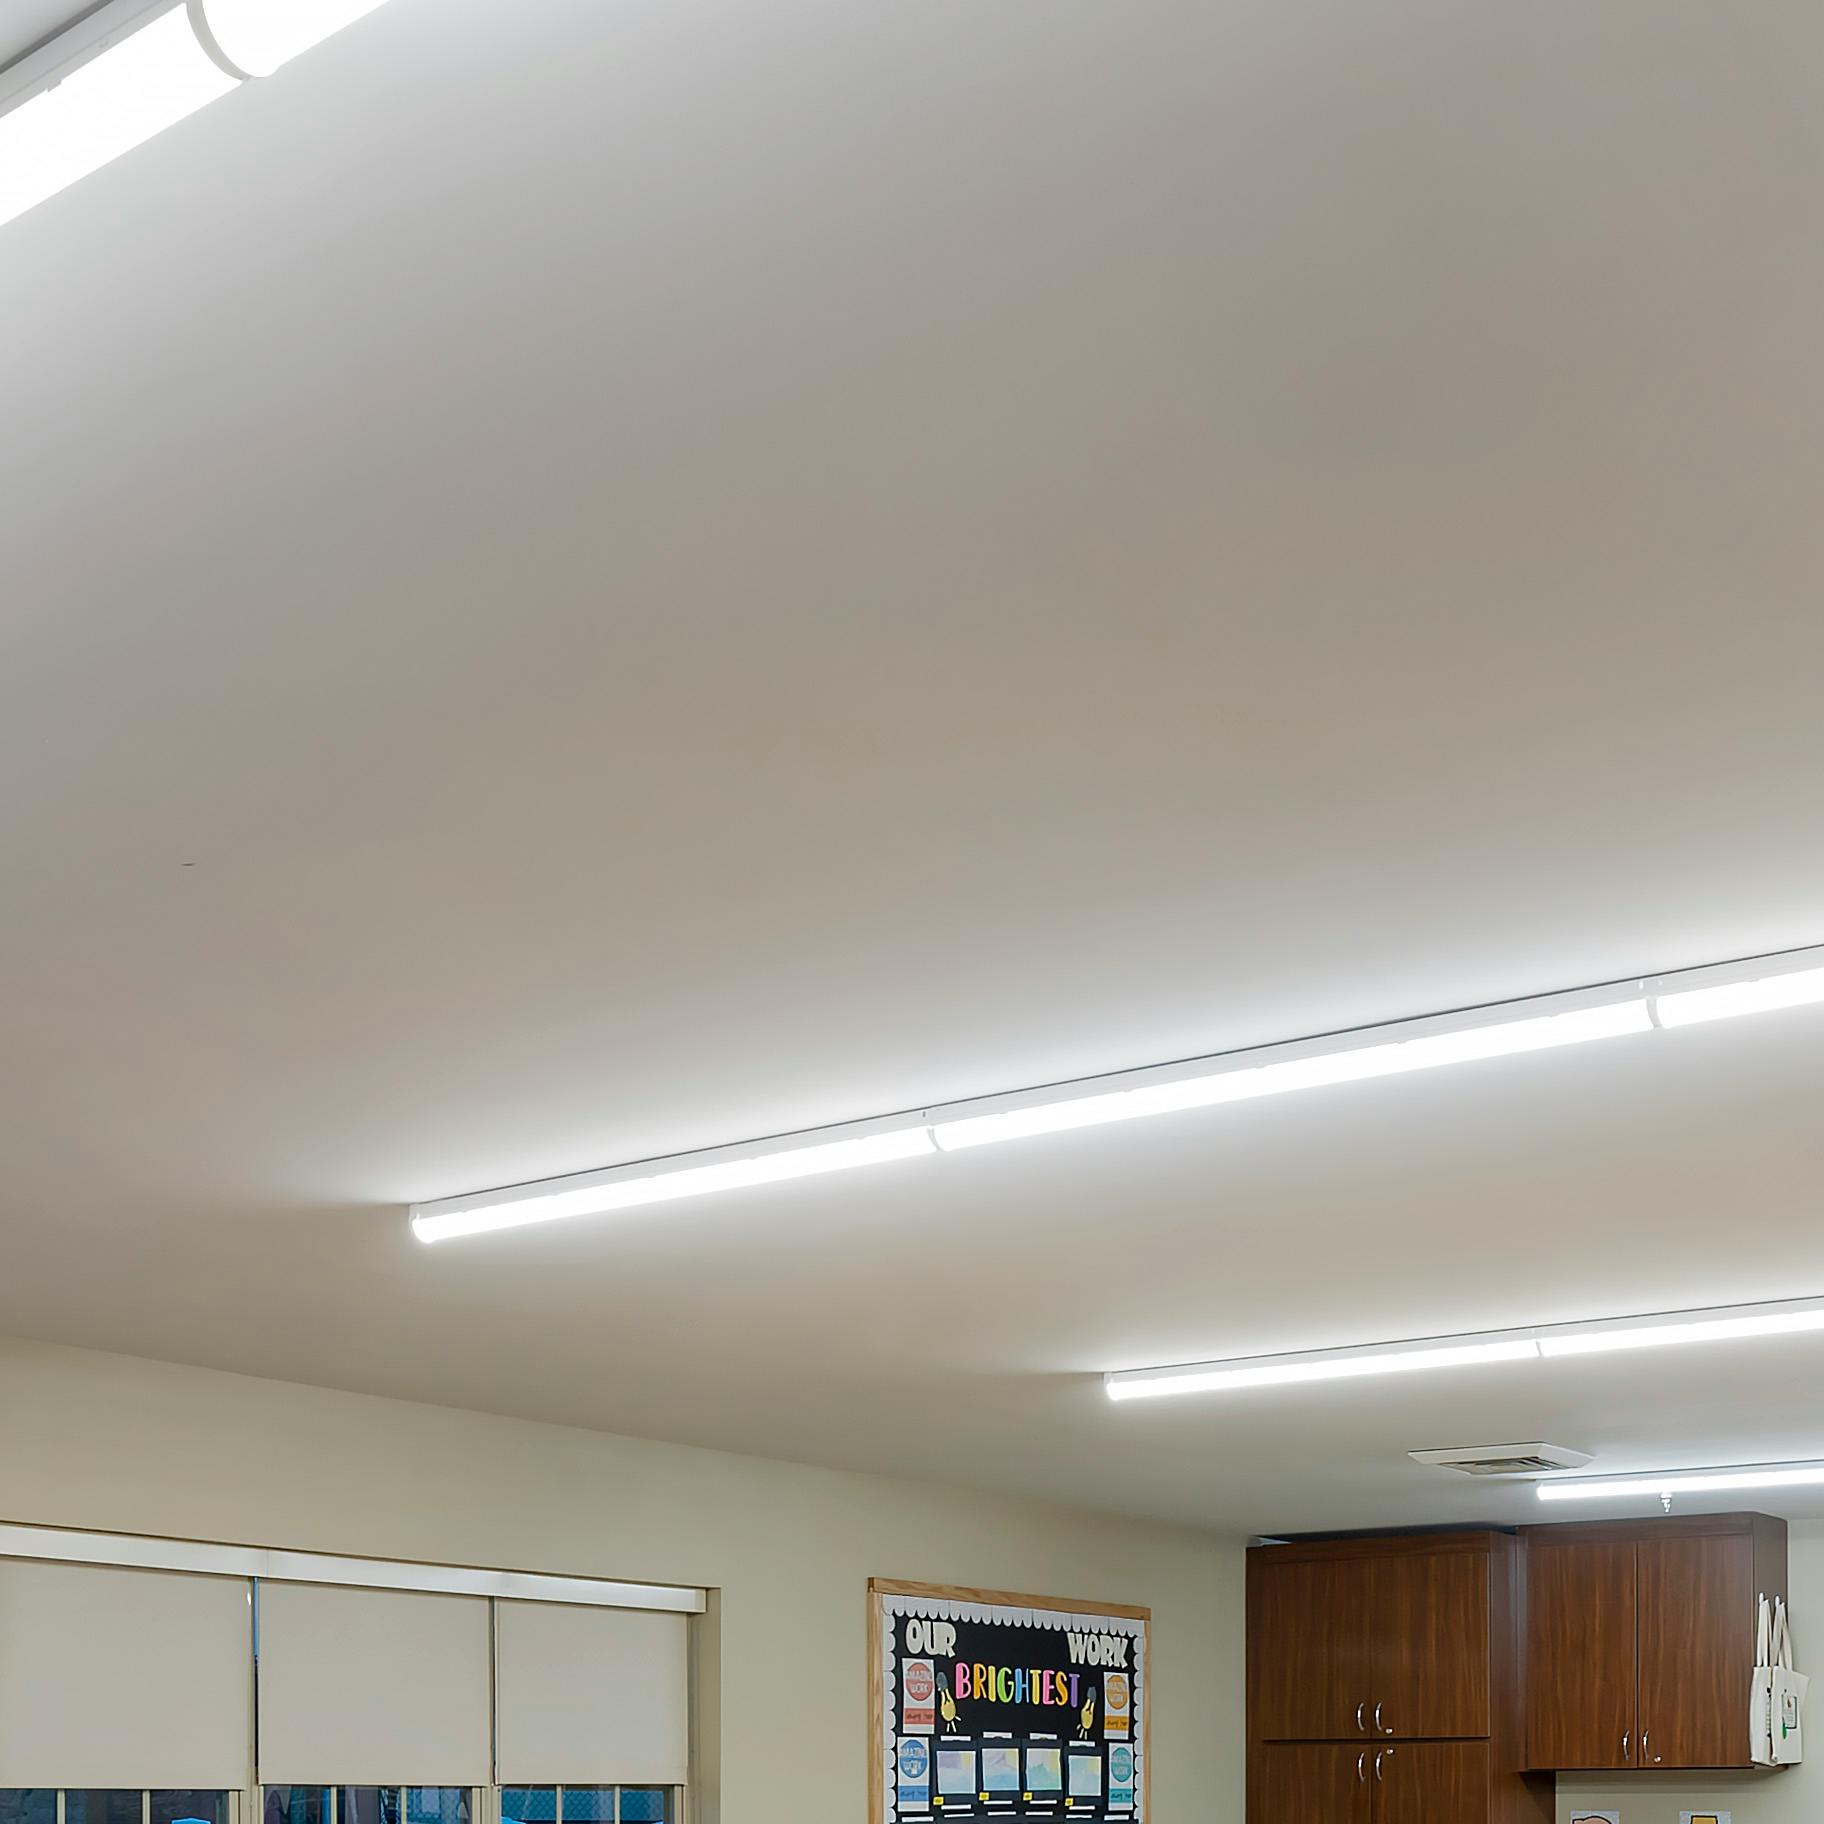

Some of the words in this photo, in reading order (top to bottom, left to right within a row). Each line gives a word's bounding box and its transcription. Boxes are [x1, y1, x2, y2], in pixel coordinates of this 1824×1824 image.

[905, 1619, 957, 1658] OUR
[1068, 1632, 1129, 1669] WORK
[956, 1662, 1081, 1708] BRIGHTEST
